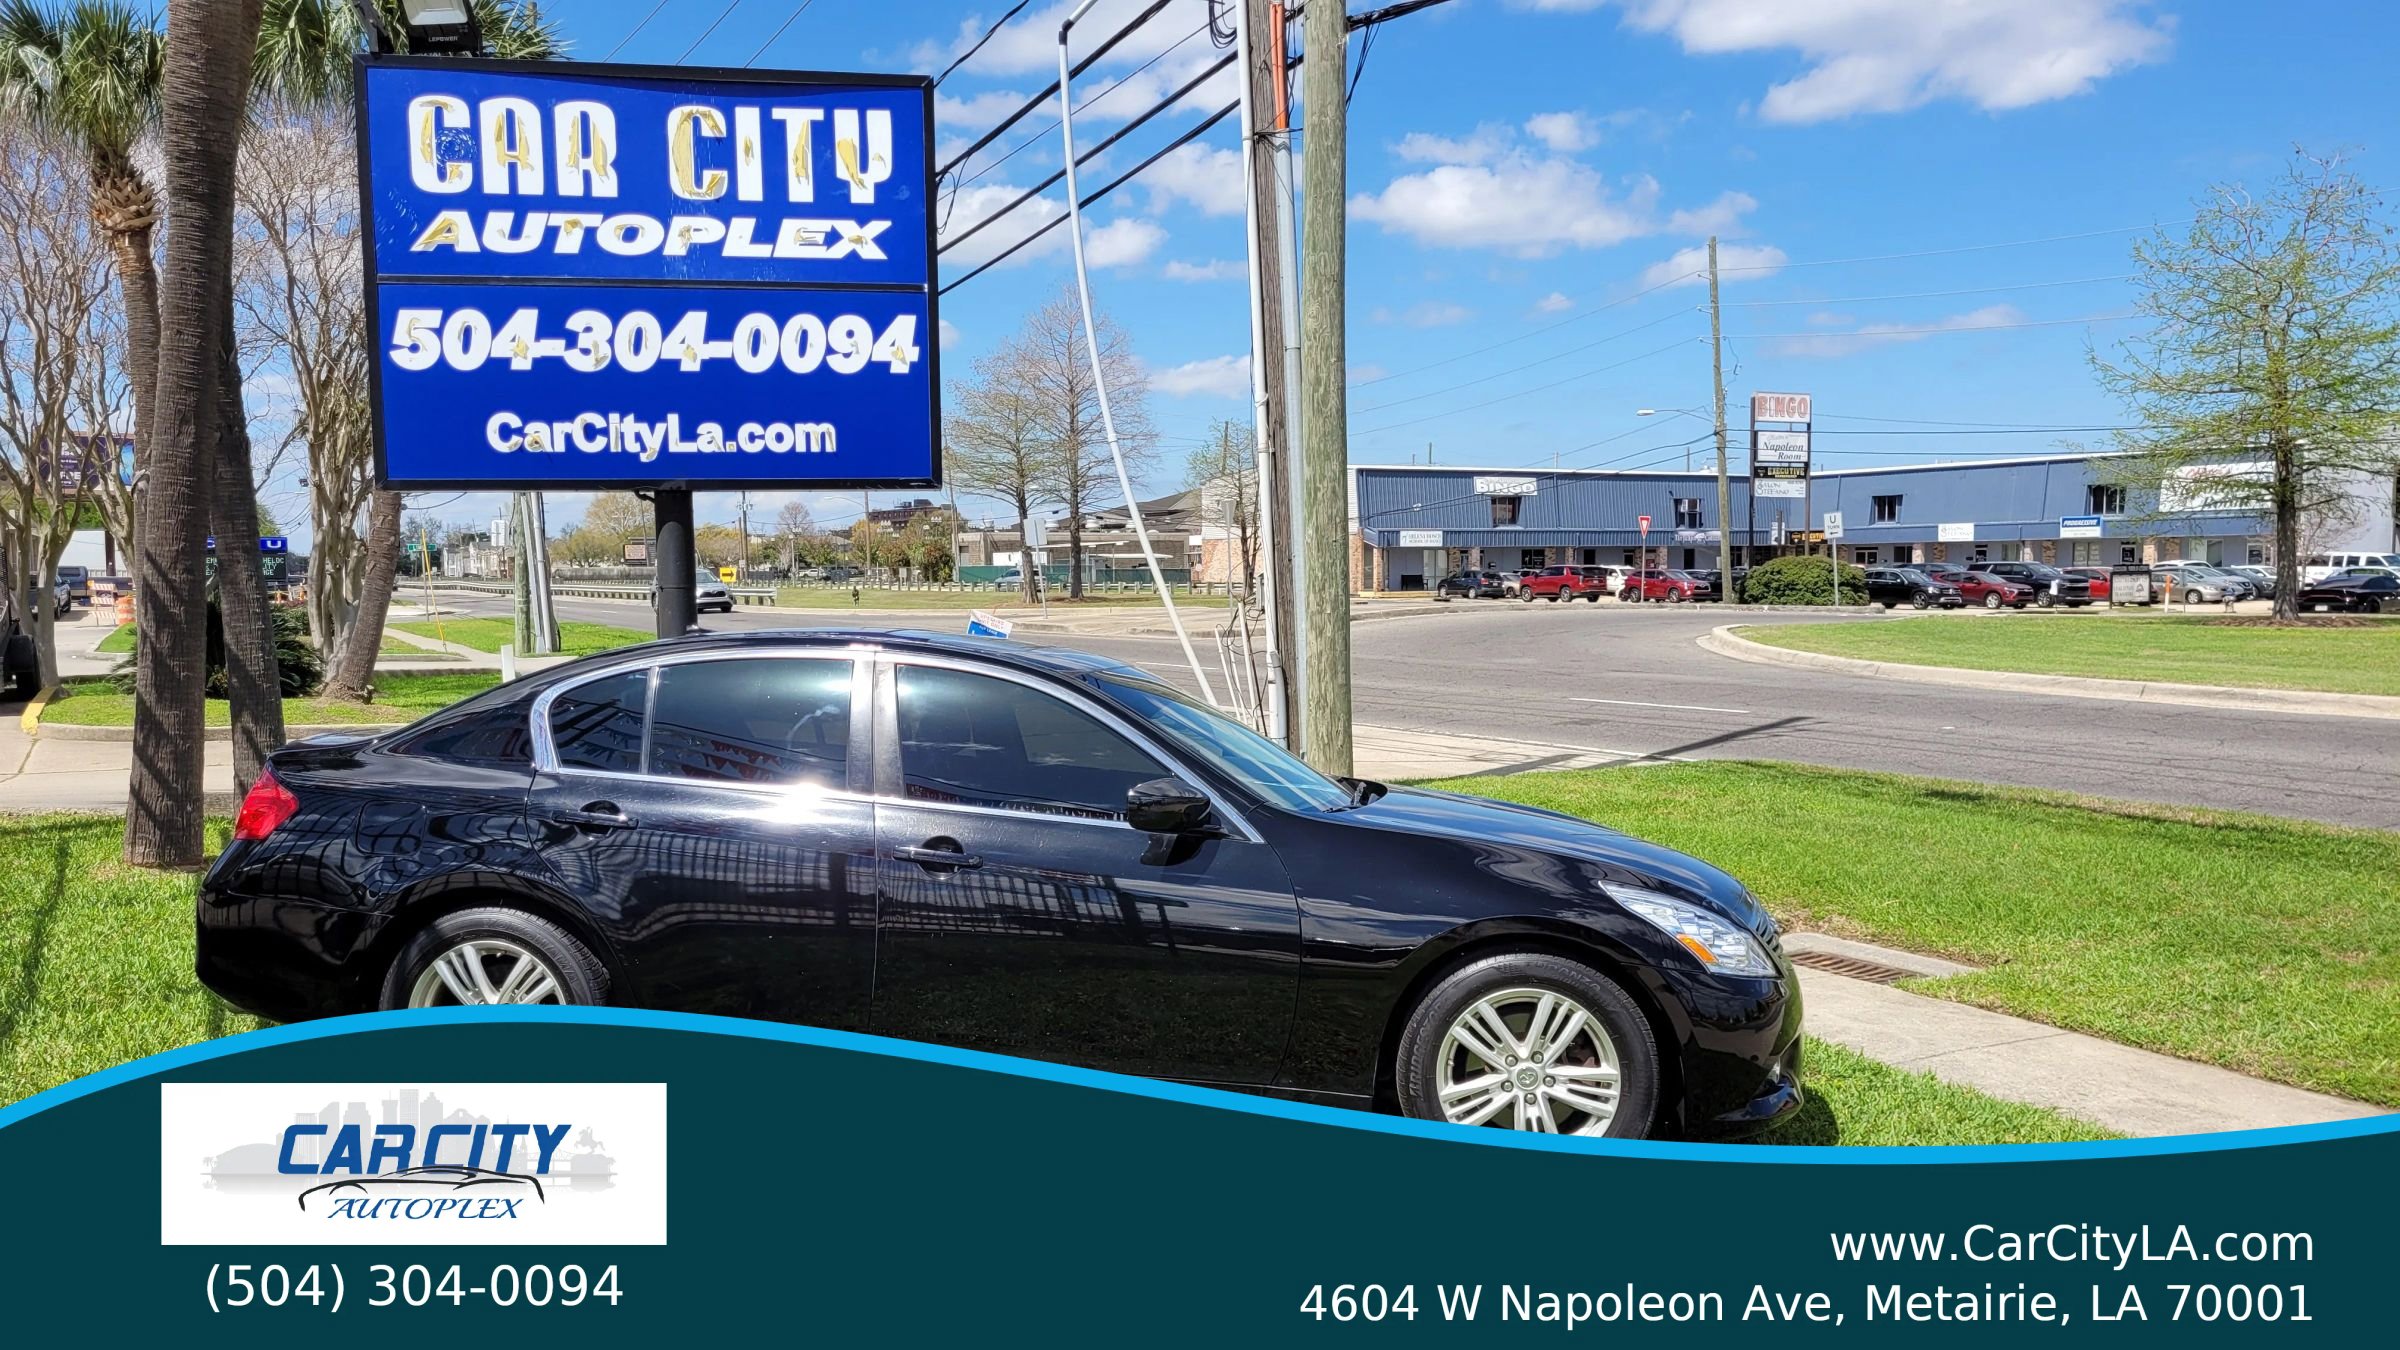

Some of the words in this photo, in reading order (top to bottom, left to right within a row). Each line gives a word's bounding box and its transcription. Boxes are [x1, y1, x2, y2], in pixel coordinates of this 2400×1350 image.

[408, 95, 618, 198] CAR
[667, 105, 893, 204] CITY
[410, 211, 892, 260] AUTOPLEX
[389, 308, 920, 375] 504-304-0094
[1757, 396, 1808, 418] BINGO
[486, 412, 837, 463] CarCityLa.com
[1762, 441, 1804, 453] Napoleon
[1777, 451, 1802, 461] Room
[1767, 467, 1805, 475] EXECUTIVE
[1475, 477, 1536, 494] BINGO
[1829, 515, 1836, 524] U
[266, 540, 282, 548] U
